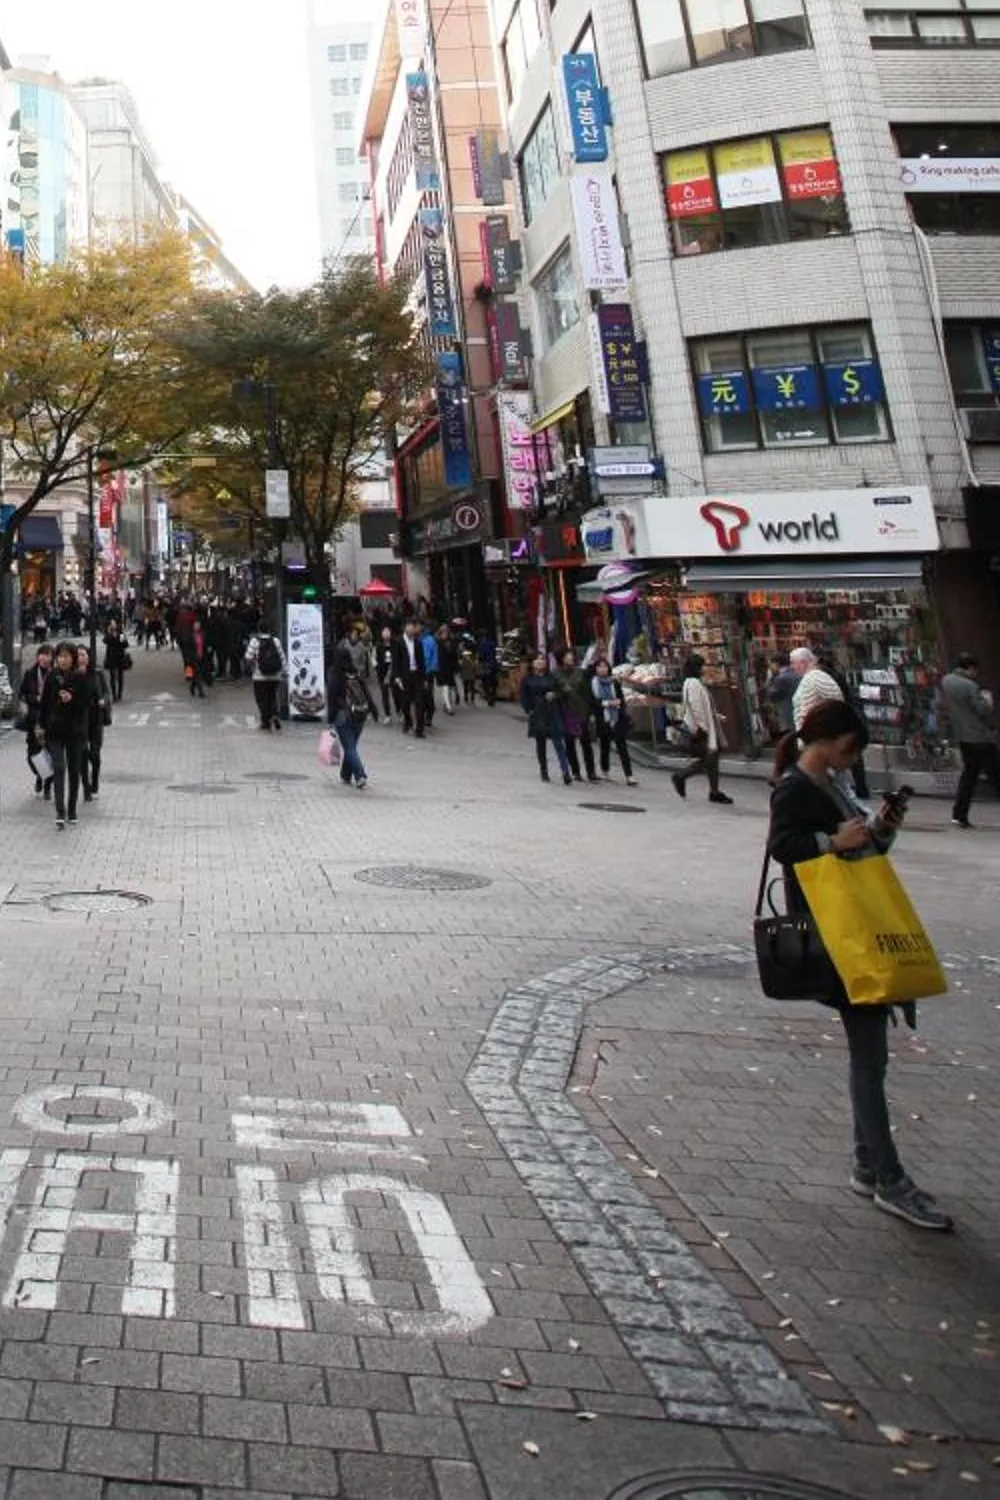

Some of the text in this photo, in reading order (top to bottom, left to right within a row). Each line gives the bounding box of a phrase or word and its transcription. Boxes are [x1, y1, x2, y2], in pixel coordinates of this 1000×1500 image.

[919, 165, 943, 176] Ring
[943, 165, 979, 176] making
[712, 379, 738, 404] 元
[841, 367, 861, 396] $
[757, 512, 840, 543] world
